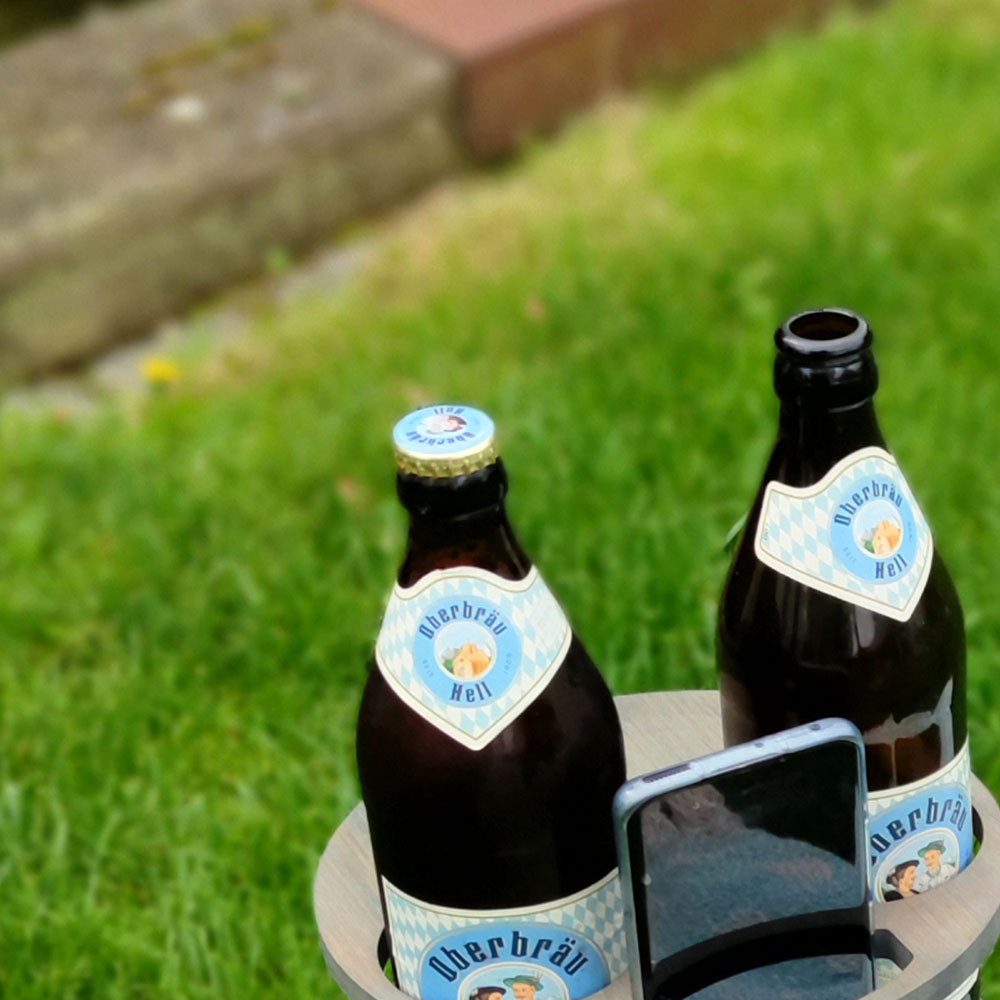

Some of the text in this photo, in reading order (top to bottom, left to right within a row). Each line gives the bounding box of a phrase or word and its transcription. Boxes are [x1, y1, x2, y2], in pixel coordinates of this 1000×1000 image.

[834, 480, 903, 526] Oberbräu
[875, 554, 907, 579] Hell
[418, 600, 508, 640] Oberbräu
[450, 681, 492, 702] Hell
[870, 794, 967, 866] berbräu
[428, 930, 590, 983] Oberbräu
